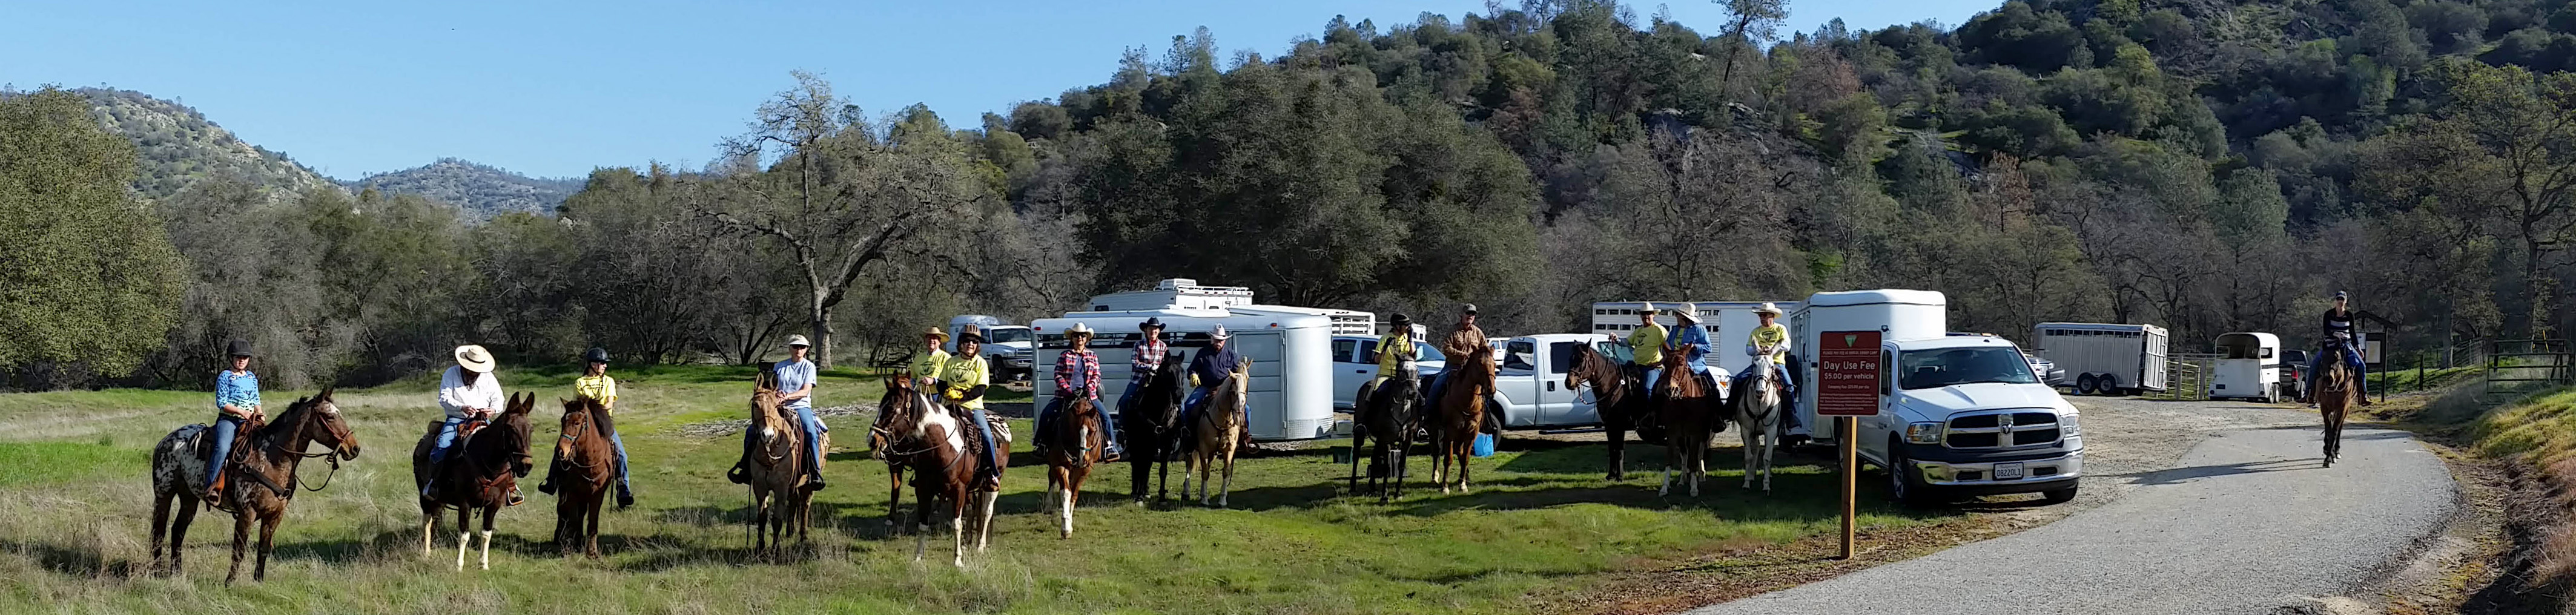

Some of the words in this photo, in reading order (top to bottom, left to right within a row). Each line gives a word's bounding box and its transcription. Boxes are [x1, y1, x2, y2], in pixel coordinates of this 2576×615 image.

[1823, 361, 1841, 372] Day
[1843, 361, 1858, 370] Use
[1860, 361, 1875, 370] Fee
